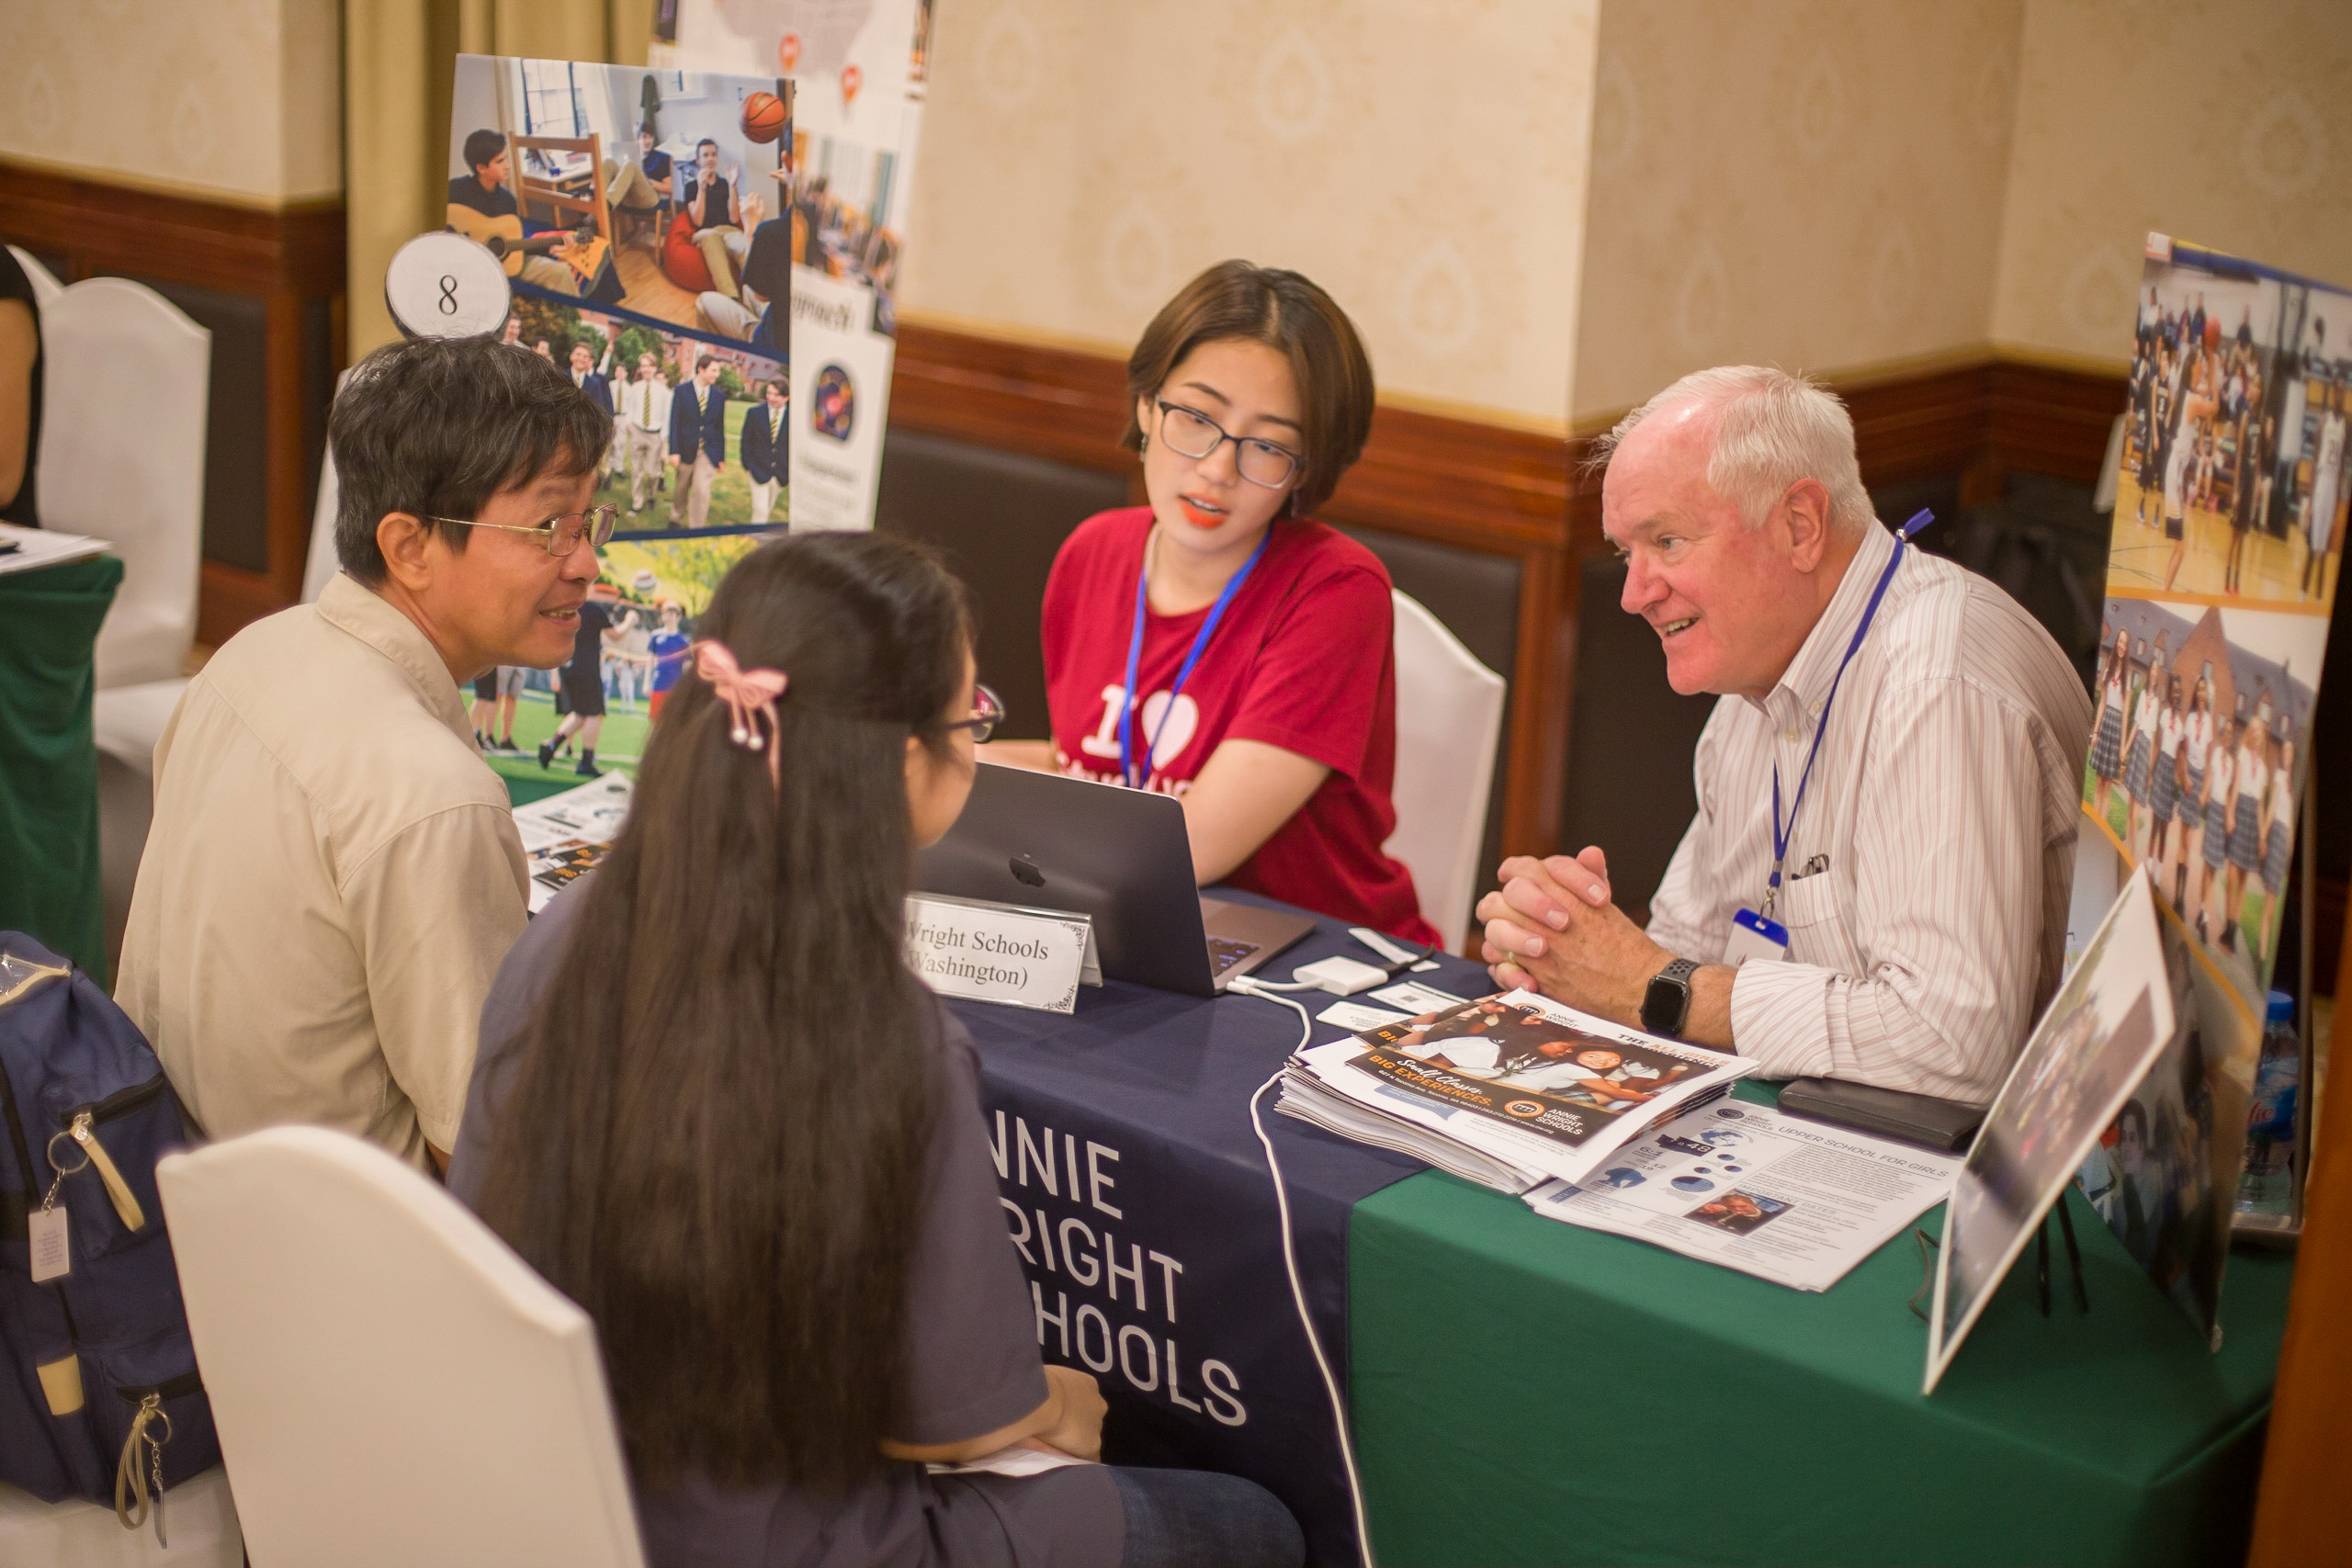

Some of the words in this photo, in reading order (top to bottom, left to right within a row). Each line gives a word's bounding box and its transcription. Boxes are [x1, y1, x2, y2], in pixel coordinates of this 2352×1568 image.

[439, 275, 458, 315] 8
[972, 931, 1049, 961] Schools
[908, 950, 1028, 990] Washington)
[1377, 1030, 1398, 1043] BI
[1618, 1033, 1648, 1045] THE
[1369, 1055, 1396, 1069] BIG
[1394, 1066, 1493, 1106] EXPERIENCES.
[1396, 1059, 1442, 1078] Small
[1535, 1116, 1583, 1135] SCHOOLS
[1543, 1112, 1583, 1127] WRIGHT
[1548, 1109, 1582, 1121] ANNIE
[989, 1110, 1124, 1220] NNIE
[1778, 1126, 1825, 1143] UPPER
[1824, 1139, 1876, 1158] SCHOOL
[1879, 1155, 1907, 1168] FOR
[1907, 1162, 1949, 1178] GIRLS
[1737, 1183, 1800, 1203] IMPORTANT
[1801, 1201, 1838, 1215] DATES
[1000, 1196, 1183, 1324] RIGHT
[1031, 1280, 1247, 1427] HOOLS
